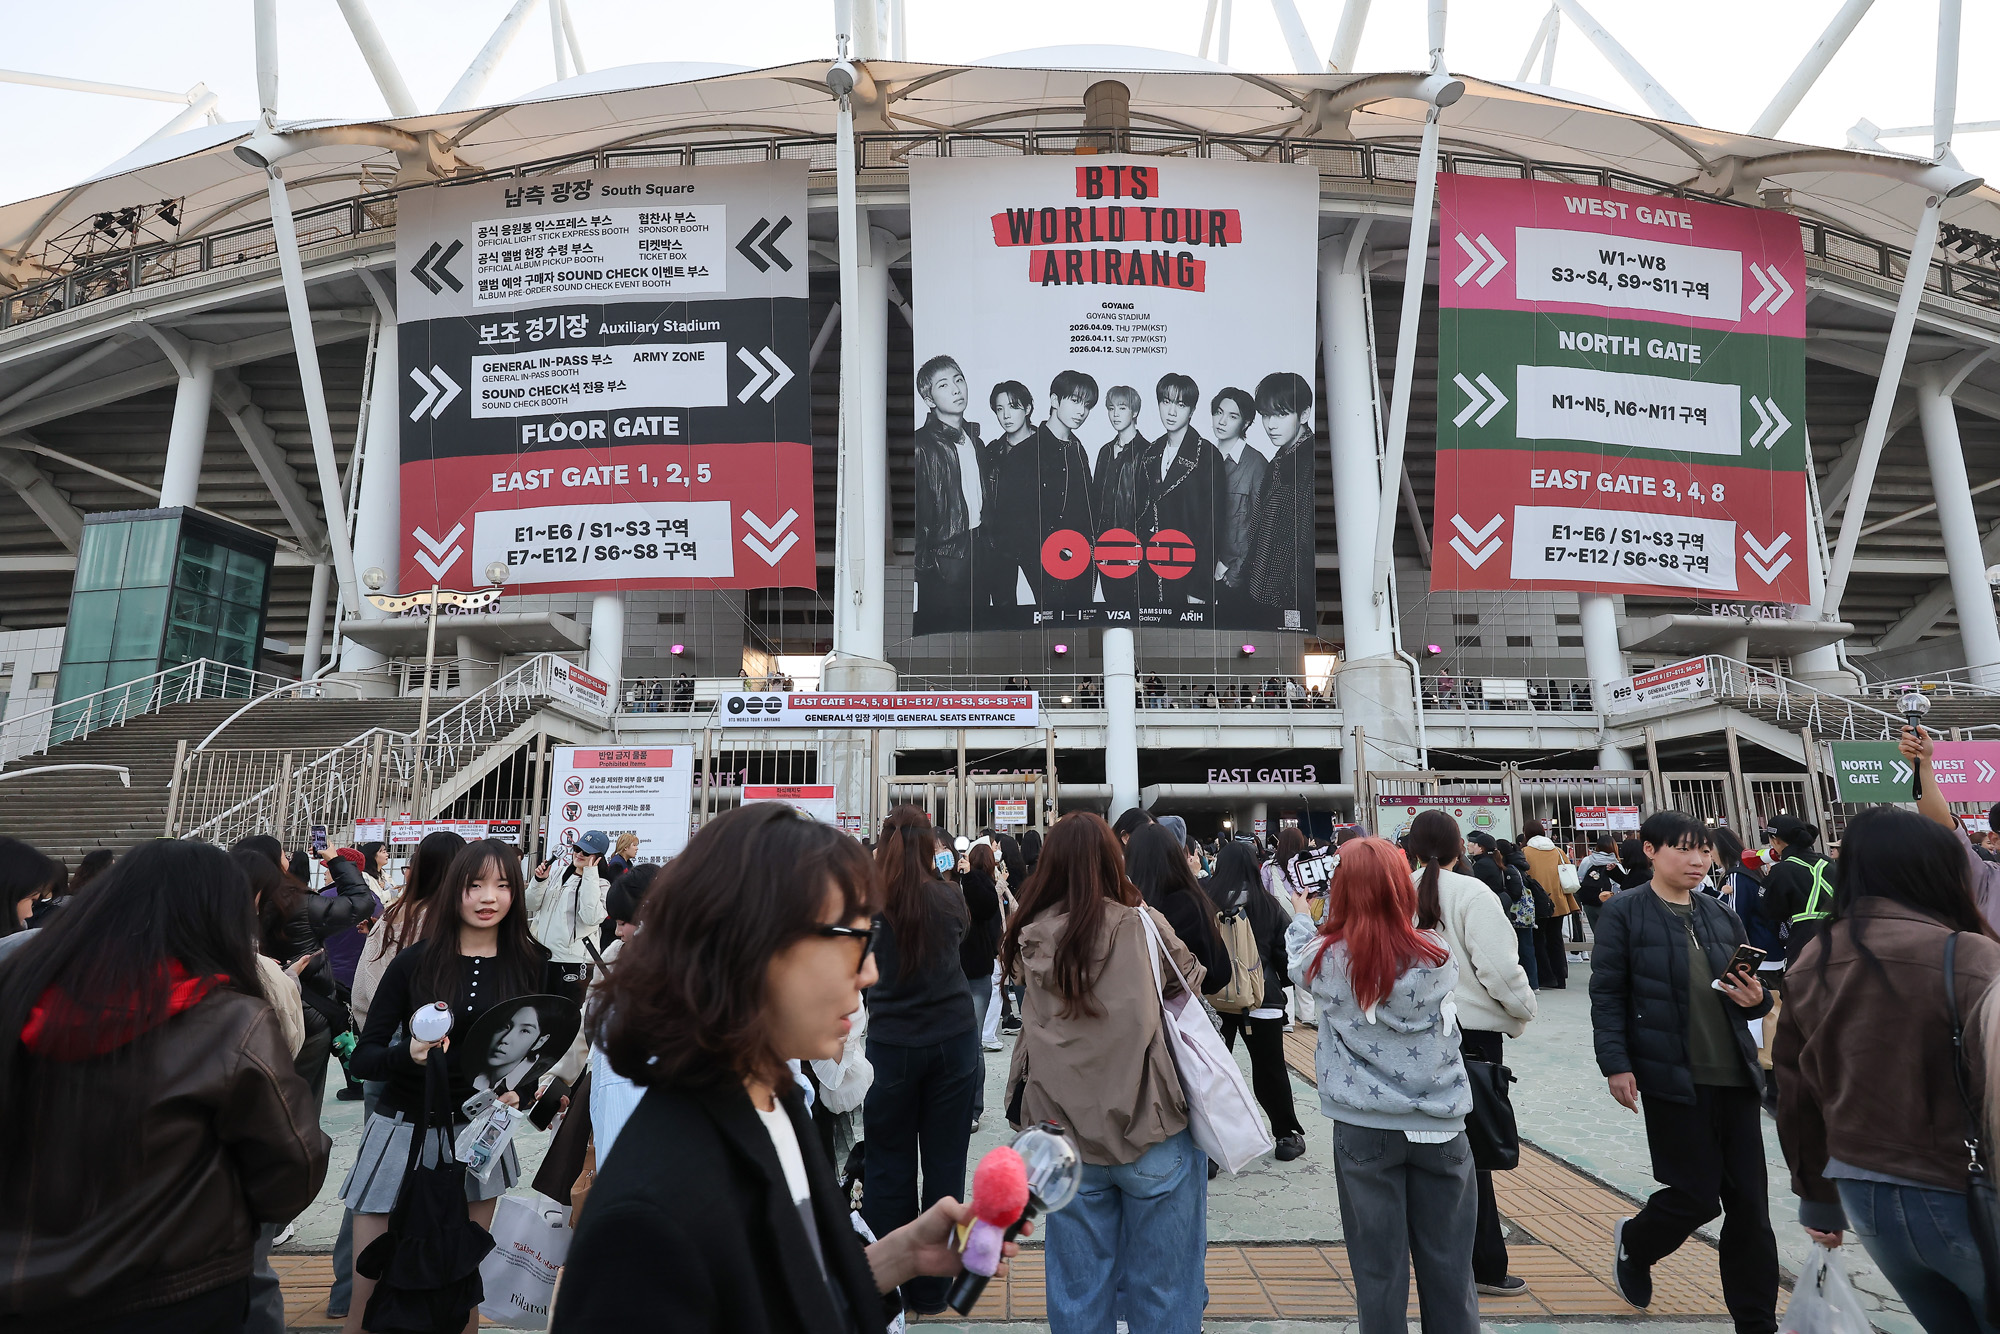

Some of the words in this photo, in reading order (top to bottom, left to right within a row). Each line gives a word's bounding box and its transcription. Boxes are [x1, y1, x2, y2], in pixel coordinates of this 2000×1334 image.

[1086, 165, 1148, 200] BTS
[504, 184, 546, 208] 남측
[550, 179, 594, 203] 광장
[600, 184, 642, 197] South
[645, 183, 695, 197] Square
[638, 212, 672, 225] 협찬사
[674, 211, 697, 224] 부스
[1563, 195, 1629, 220] WEST
[1635, 206, 1694, 230] GATE
[477, 225, 499, 239] 공식
[501, 222, 532, 236] 응원봉
[535, 217, 588, 232] 익스프레스
[590, 215, 613, 228] 부스
[638, 225, 679, 234] SPONSOR
[680, 224, 709, 233] BOOTH
[1006, 206, 1126, 245] WORLD
[1140, 206, 1228, 248] TOUR
[477, 237, 513, 248] OFFICIAL
[514, 234, 537, 244] LIGHT
[538, 231, 561, 242] STICK
[562, 228, 600, 239] EXPRESS
[601, 226, 629, 237] BOOTH
[638, 239, 683, 252] 티켓박스
[477, 251, 499, 265] 공식
[501, 249, 522, 263] 앨범
[524, 246, 545, 260] 현장
[547, 243, 568, 257] 수령
[571, 242, 594, 255] 부스
[639, 252, 668, 261] TICKET
[669, 252, 687, 260] BOX
[1598, 249, 1667, 272] W1~W8
[477, 263, 513, 274] OFFICIAL
[514, 260, 541, 270] ALBUM
[542, 257, 573, 266] PICKUP
[574, 255, 604, 264] BOOTH
[1041, 248, 1195, 288] ARIRANG
[477, 277, 499, 292] 앨범
[501, 275, 522, 289] 예약
[524, 271, 555, 286] 구매자
[557, 270, 603, 281] SOUND
[605, 267, 649, 279] CHECK
[651, 265, 685, 279] 이벤트
[687, 265, 710, 278] 부스
[1551, 266, 1613, 291] S3~S4,
[1617, 273, 1678, 294] S9~S11
[1681, 280, 1710, 300] 구역
[477, 290, 506, 300] ALBUM
[508, 285, 552, 298] PRE-ORDER
[553, 282, 583, 292] SOUND
[584, 281, 614, 291] CHECK
[614, 280, 640, 289] EVENT
[642, 279, 671, 288] BOOTH
[1101, 302, 1135, 310] GOYANG
[1086, 312, 1117, 321] GOYANG
[1117, 313, 1151, 321] STADIUM
[478, 321, 521, 345] 보조
[525, 313, 590, 342] 경기장
[598, 320, 660, 336] Auxiliary
[663, 319, 721, 333] Stadium
[1069, 323, 1114, 332] 2026.04.09.
[1115, 324, 1130, 332] THU
[1131, 324, 1168, 333] 7PM(KST)
[1070, 334, 1115, 343] 2026.04.11.
[1116, 335, 1129, 343] SAT
[1131, 335, 1168, 344] 7PM(KST)
[1559, 330, 1641, 356] NORTH
[1647, 338, 1702, 364] GATE
[633, 351, 669, 363] ARMY
[671, 350, 705, 362] ZONE
[1069, 345, 1114, 354] 2026.04.12.
[1115, 346, 1131, 354] SUN
[1131, 346, 1168, 355] 7PM(KST)
[482, 359, 538, 373] GENERAL
[539, 354, 589, 368] IN-PASS
[591, 353, 613, 366] 부스
[481, 374, 520, 383] GENERAL
[521, 370, 550, 380] IN-PASS
[551, 368, 579, 378] BOOTH
[482, 388, 526, 400] SOUND
[582, 381, 605, 394] 전용
[607, 379, 627, 392] 부스
[481, 401, 512, 410] SOUND
[513, 399, 540, 409] CHECK
[541, 397, 568, 407] BOOTH
[1552, 394, 1610, 418] N1~N5,
[1614, 399, 1676, 421] N6~N11
[1679, 405, 1707, 426] 구역
[522, 419, 607, 444] FLOOR
[613, 416, 680, 438] GATE
[491, 467, 555, 493] EAST
[561, 464, 630, 487] GATE
[637, 463, 659, 488] 1,
[666, 463, 690, 488] 2,
[696, 463, 712, 484] 5
[1530, 468, 1592, 490] EAST
[1596, 472, 1657, 496] GATE
[1662, 478, 1682, 503] 3,
[1687, 481, 1706, 505] 4,
[1711, 482, 1726, 503] 8
[515, 523, 573, 543] E1~E6
[589, 520, 651, 539] S1~S3
[655, 518, 690, 538] 구역
[1552, 524, 1606, 542] E1~E6
[1621, 528, 1674, 547] S1~S3
[1677, 532, 1704, 552] 구역
[507, 547, 578, 566] E7~E12
[594, 543, 659, 561] S6~S8
[662, 541, 698, 561] 구역
[1544, 546, 1609, 564] E7~E12
[1623, 550, 1680, 570] S6~S8
[1682, 554, 1709, 574] 구역
[1105, 610, 1132, 621] VISA
[1139, 608, 1173, 616] SAMSUNG
[1139, 615, 1162, 623] Galaxy
[1711, 603, 1746, 617] EAST
[1750, 604, 1787, 619] GATE
[793, 698, 819, 706] EAST
[820, 697, 846, 706] GATE
[848, 698, 870, 707] 1~4,
[896, 697, 933, 706] E1~E12
[942, 697, 976, 707] S1~S3,
[977, 697, 1009, 706] S6~S8
[1010, 696, 1027, 706] 구역
[854, 713, 871, 723] 입장
[871, 713, 896, 723] 게이트
[896, 713, 938, 722] GENERAL
[939, 713, 967, 722] SEATS
[968, 713, 1016, 722] ENTRANCE
[598, 760, 629, 768] Prohibited
[1840, 759, 1883, 771] NORTH
[1931, 759, 1965, 770] WEST
[692, 771, 736, 787] GATE
[1207, 768, 1252, 783] EAST
[1256, 768, 1302, 783] GATE
[1303, 764, 1317, 783] 3
[1848, 773, 1881, 785] GATE
[1934, 773, 1968, 784] GATE
[587, 804, 604, 812] 타인의
[491, 825, 517, 833] FLOOR
